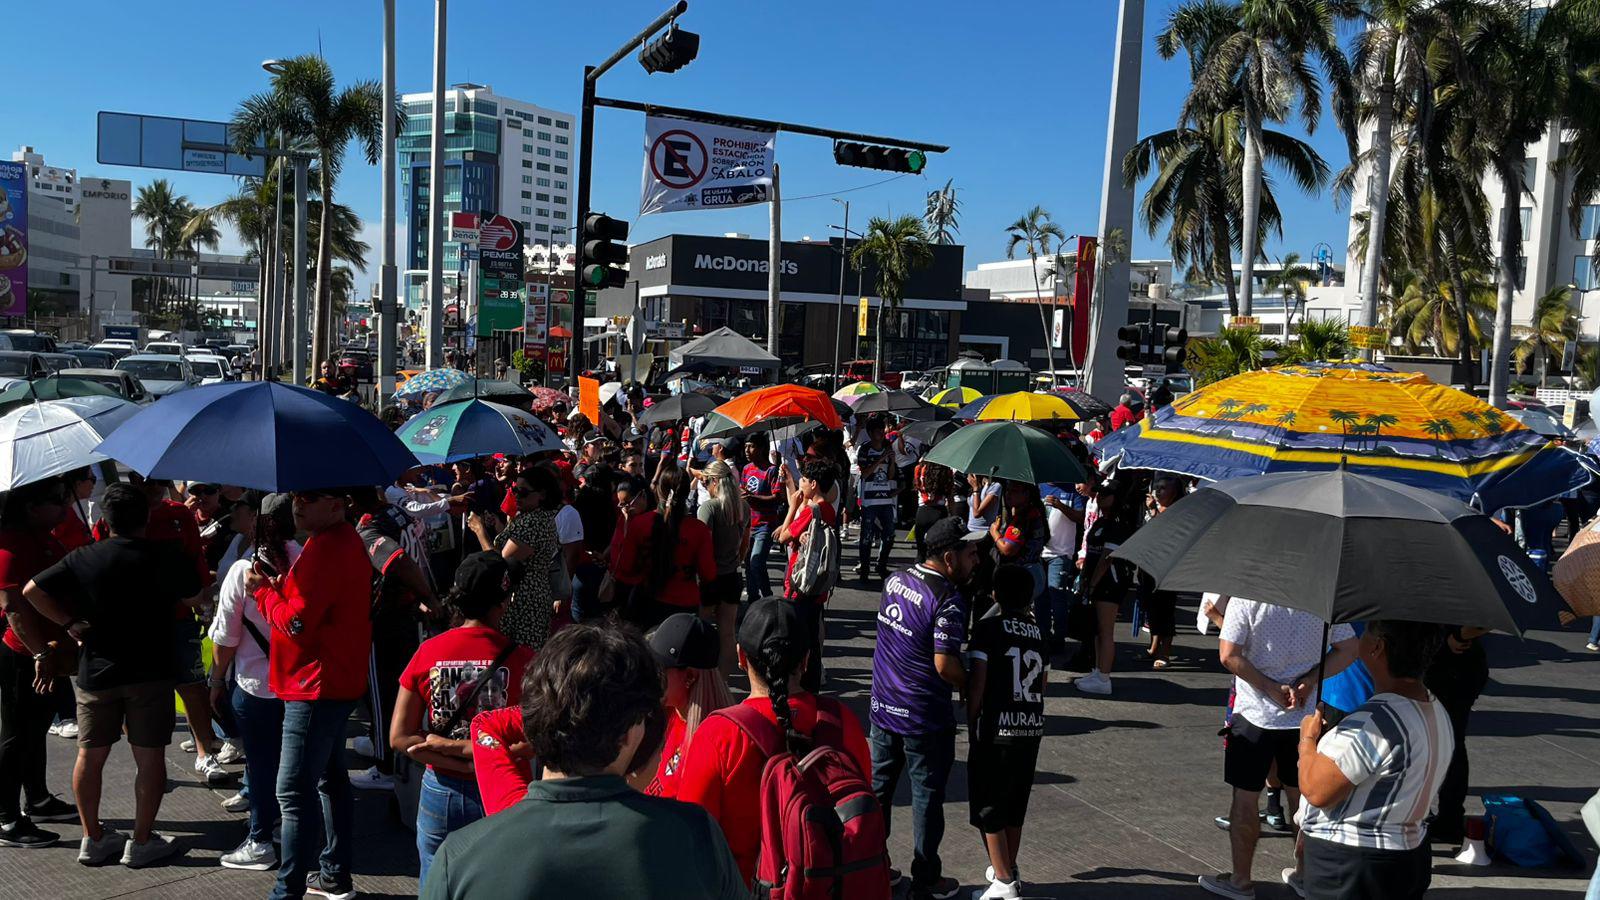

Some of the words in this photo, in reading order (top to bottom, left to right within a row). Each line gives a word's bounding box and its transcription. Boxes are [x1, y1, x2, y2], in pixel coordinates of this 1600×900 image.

[83, 190, 128, 200] EMPORIO
[482, 250, 519, 260] PEMEX
[694, 253, 799, 275] McDonad's
[886, 575, 923, 607] Corona
[890, 620, 913, 637] Azteca
[1003, 617, 1042, 640] CÉSAR
[1004, 646, 1043, 703] 12
